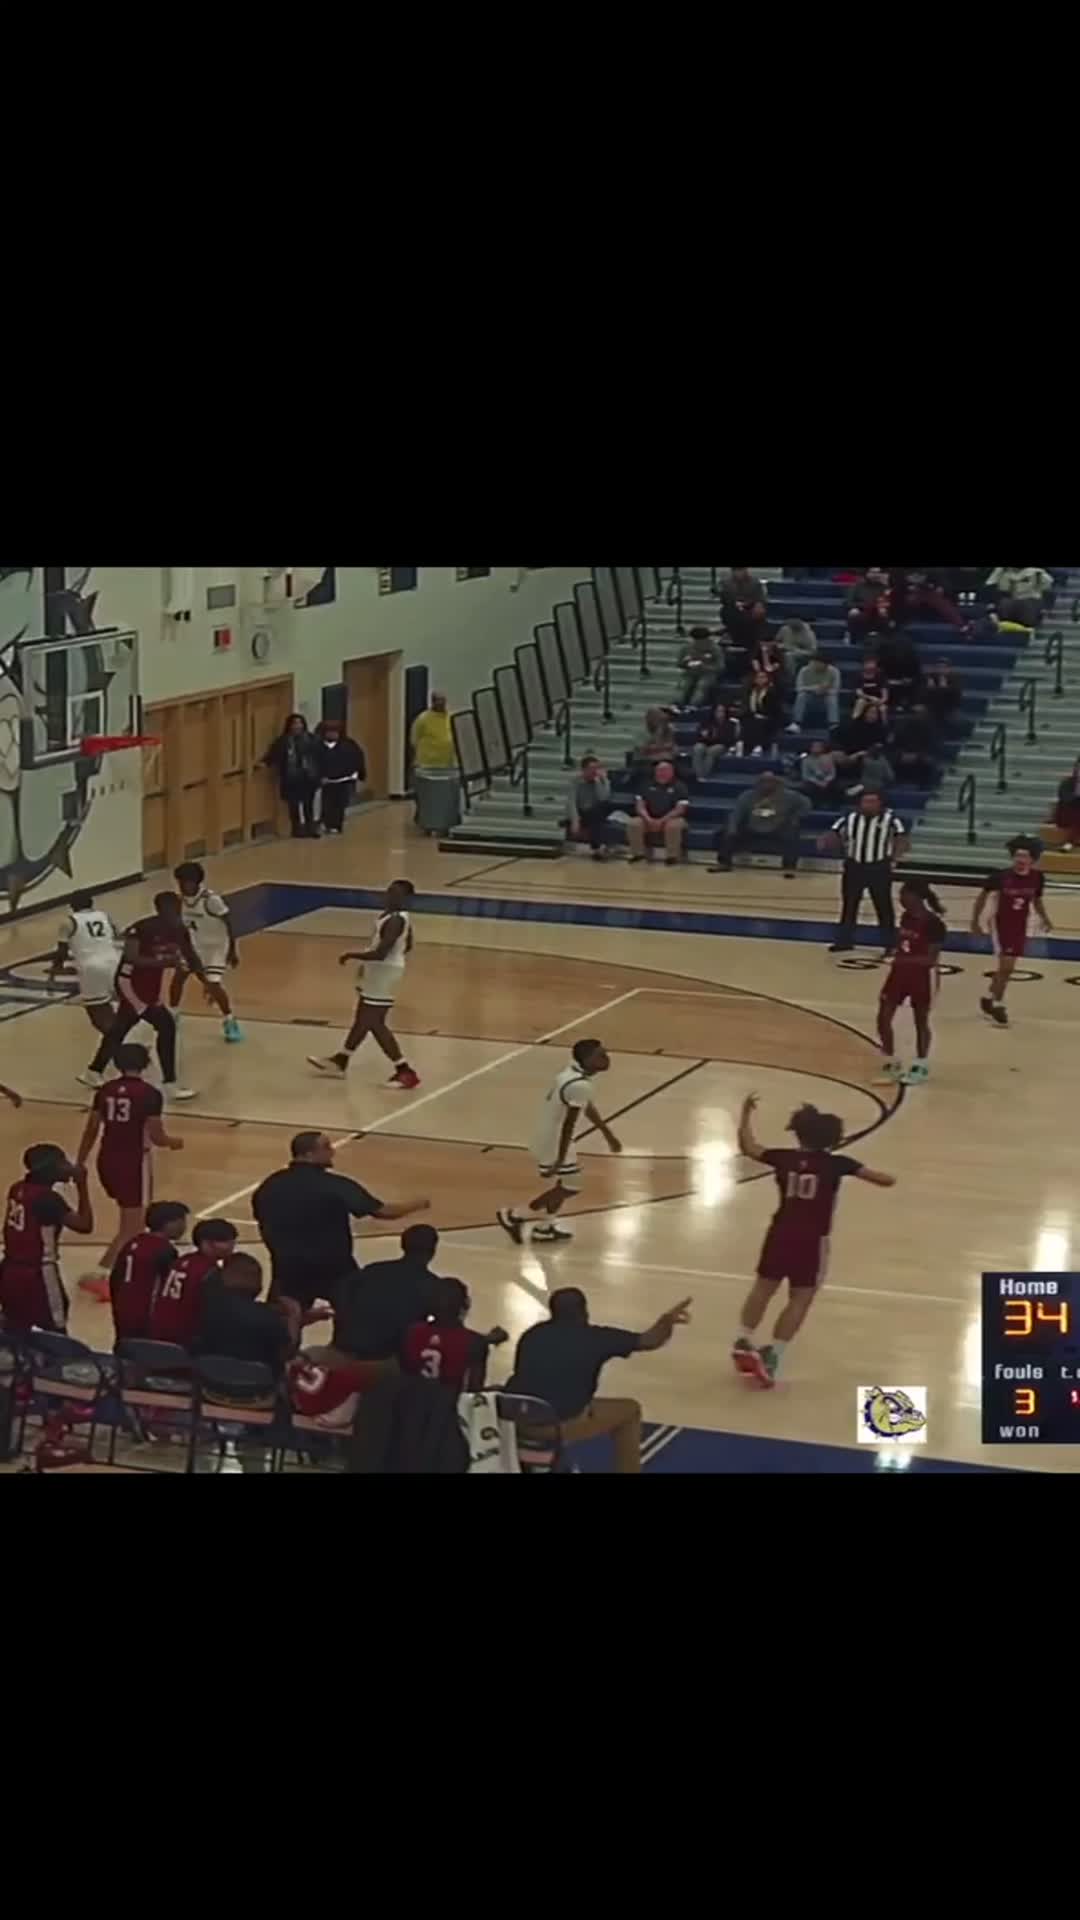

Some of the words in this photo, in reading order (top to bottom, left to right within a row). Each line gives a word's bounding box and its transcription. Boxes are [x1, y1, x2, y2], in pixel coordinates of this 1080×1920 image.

[86, 921, 106, 937] 12
[106, 1096, 131, 1122] 13
[786, 1171, 817, 1199] 10
[124, 1255, 133, 1282] 1
[162, 1270, 187, 1299] 15
[420, 1349, 442, 1378] 3
